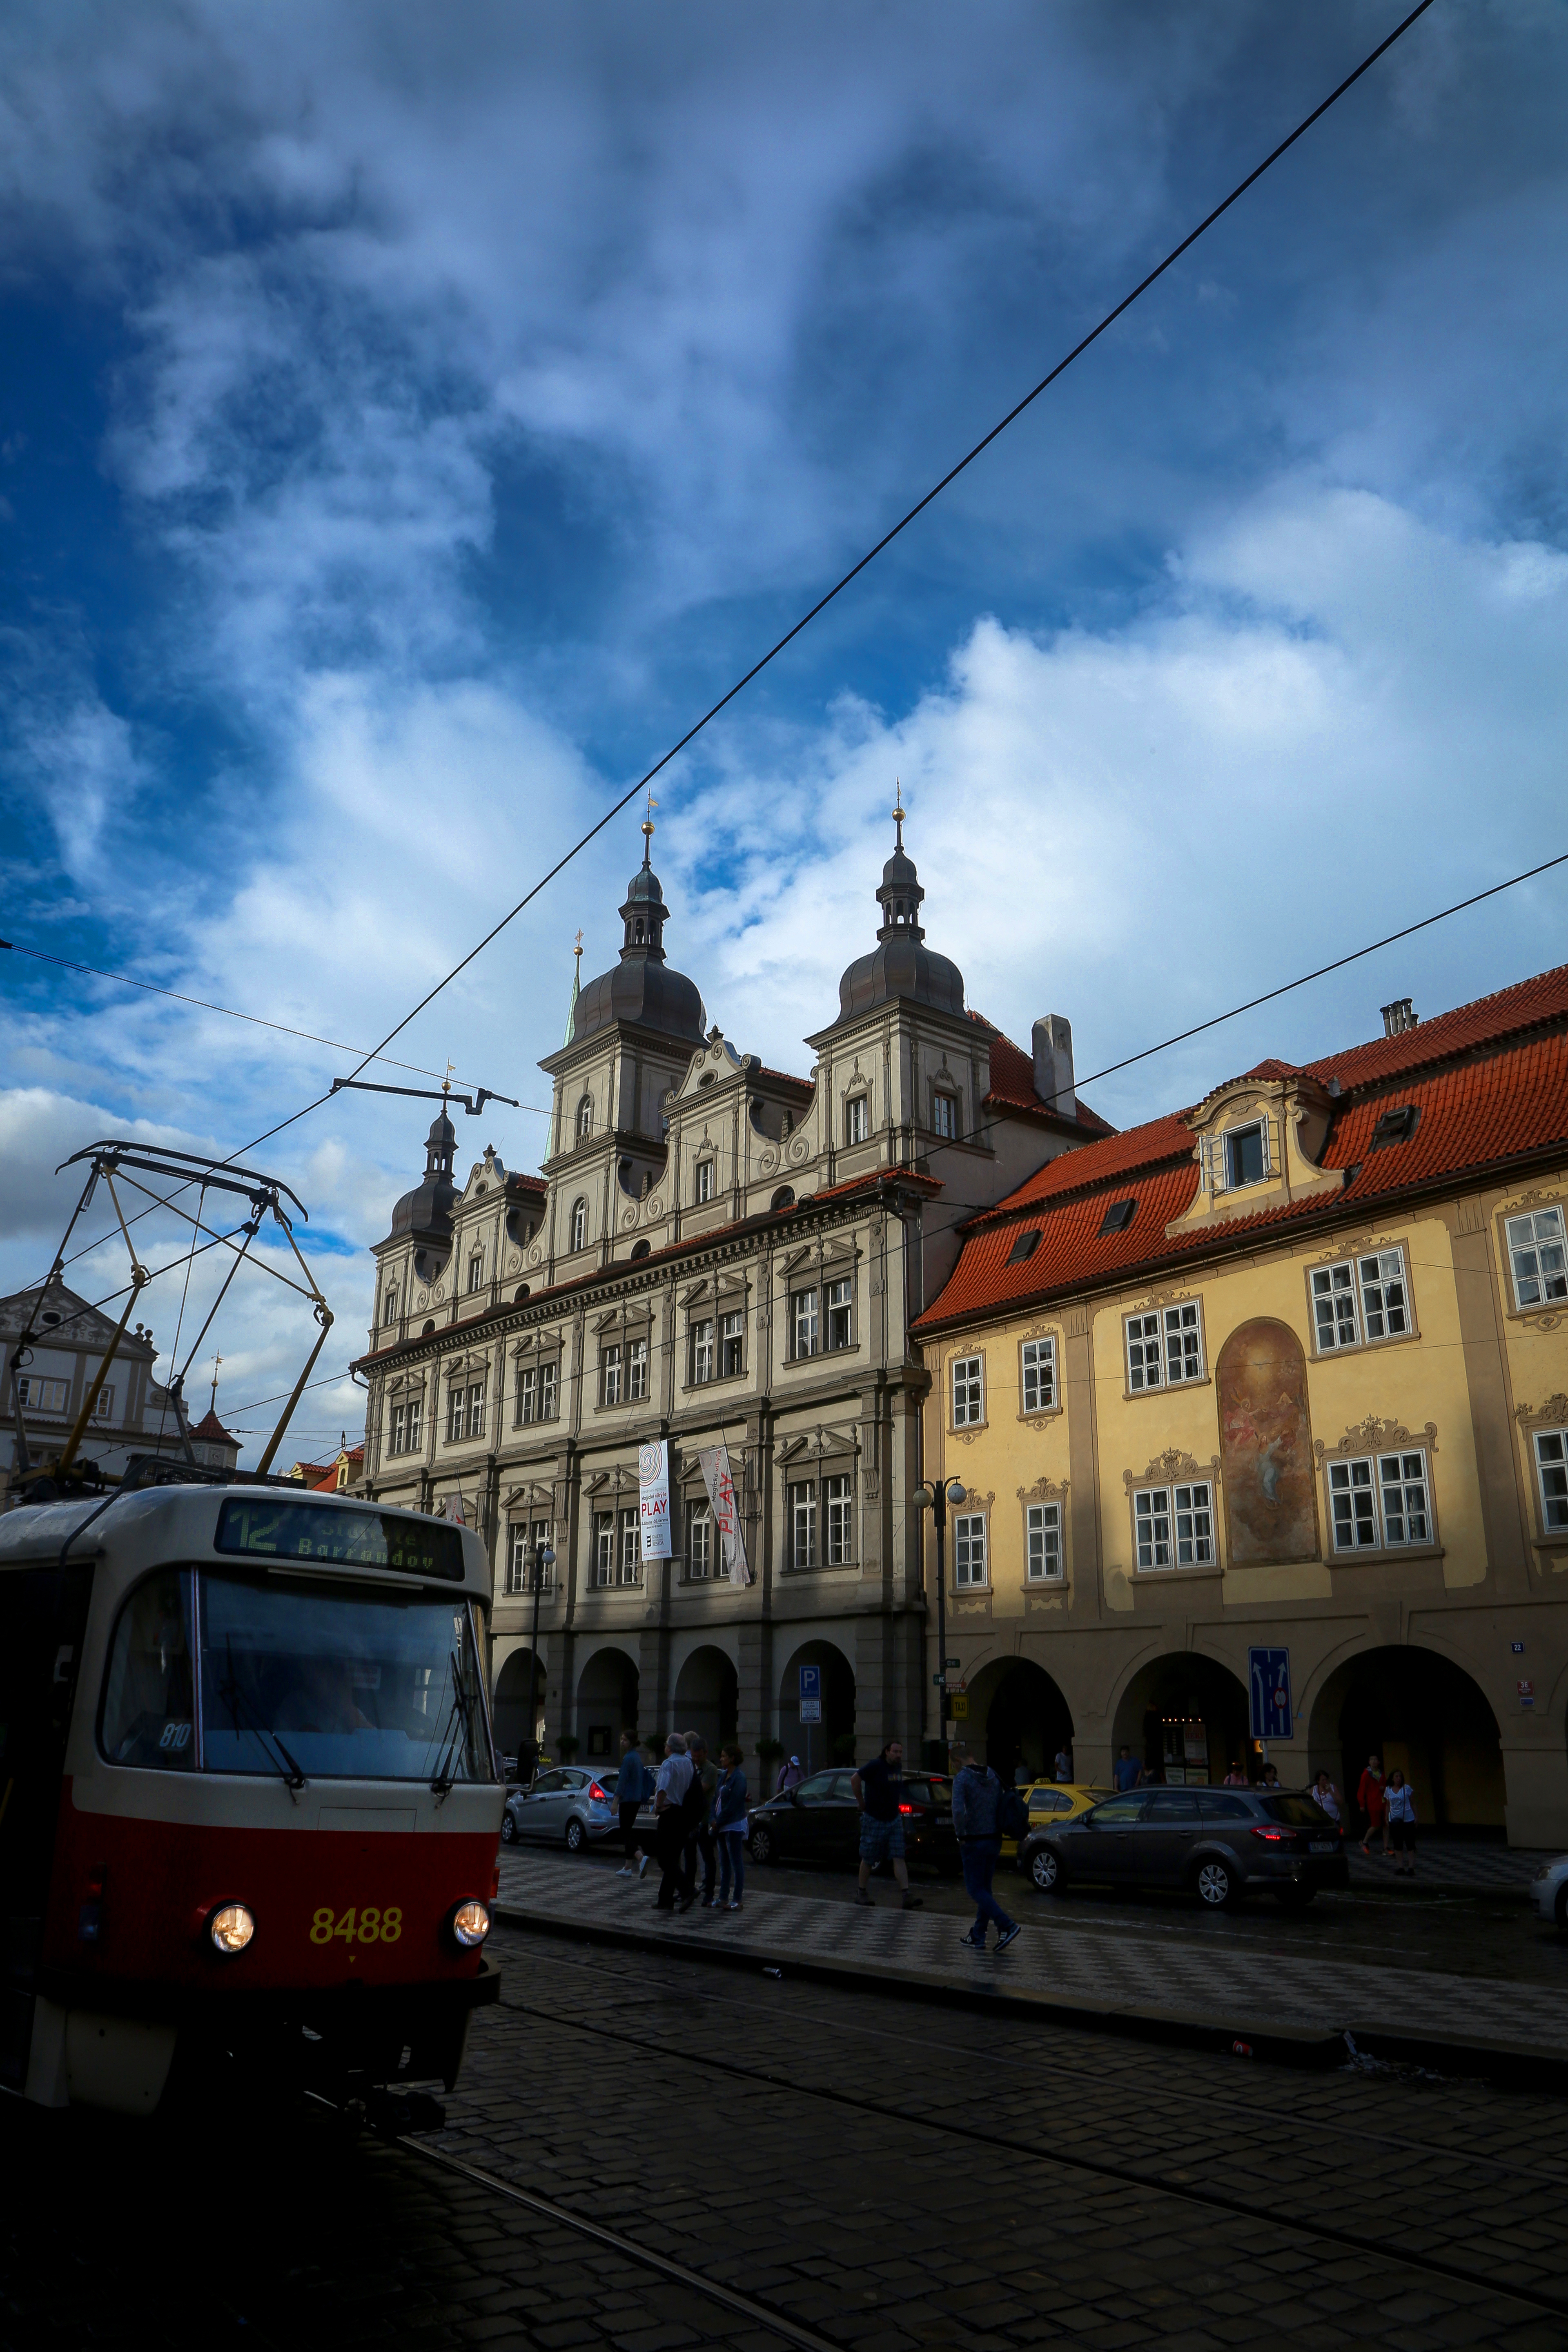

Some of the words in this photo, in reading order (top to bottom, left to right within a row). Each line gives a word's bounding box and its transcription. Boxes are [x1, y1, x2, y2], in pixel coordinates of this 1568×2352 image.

[642, 1499, 667, 1517] PLAY
[719, 1472, 733, 1534] PLAY
[230, 1510, 282, 1551] 12
[298, 1538, 433, 1568] Barrandov
[804, 1670, 815, 1688] P
[955, 1702, 966, 1711] TAXI
[160, 1723, 192, 1747] 810
[310, 1907, 402, 1944] 8488
